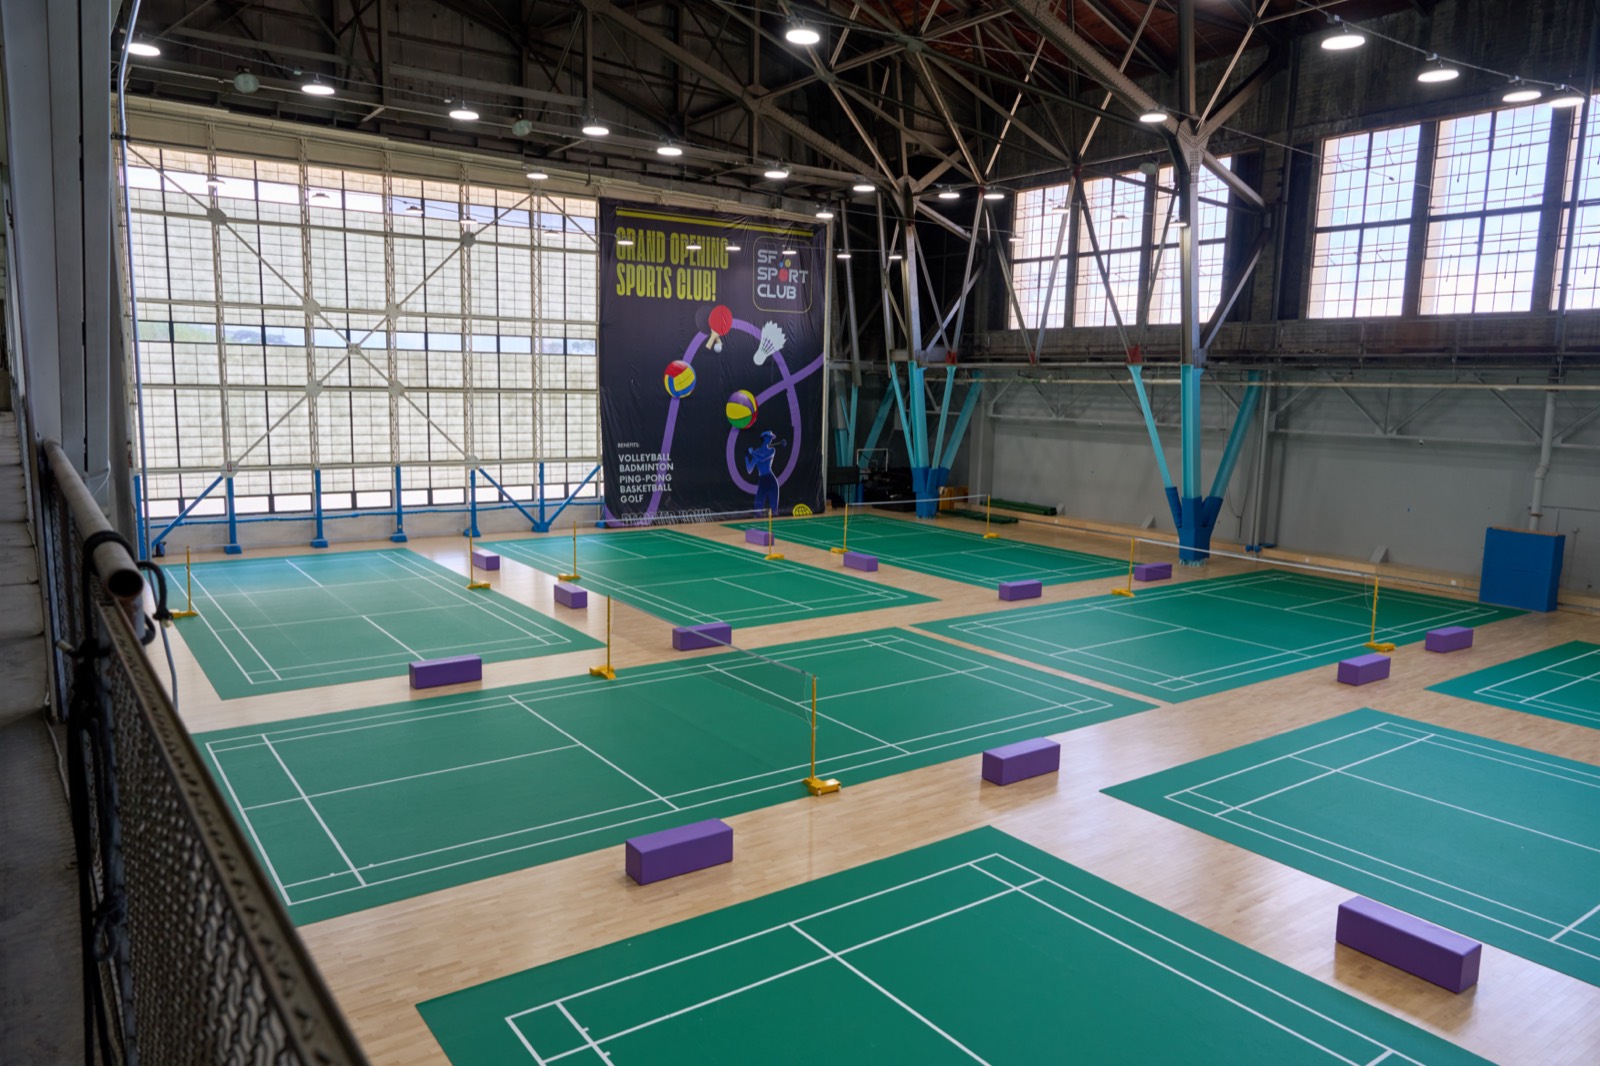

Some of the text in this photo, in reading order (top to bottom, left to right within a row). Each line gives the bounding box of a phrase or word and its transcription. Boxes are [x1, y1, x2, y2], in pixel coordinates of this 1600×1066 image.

[616, 226, 729, 270] GRAND OPENING
[757, 249, 778, 264] SF
[616, 262, 717, 302] SPORTS CLUB!
[757, 283, 797, 300] CLUB
[618, 453, 672, 463] VOLLEYBALL
[619, 462, 674, 473] BADMINTON
[619, 473, 672, 484] PING-PONG
[620, 483, 673, 494] BASKETBALL
[620, 494, 644, 504] GOLF
